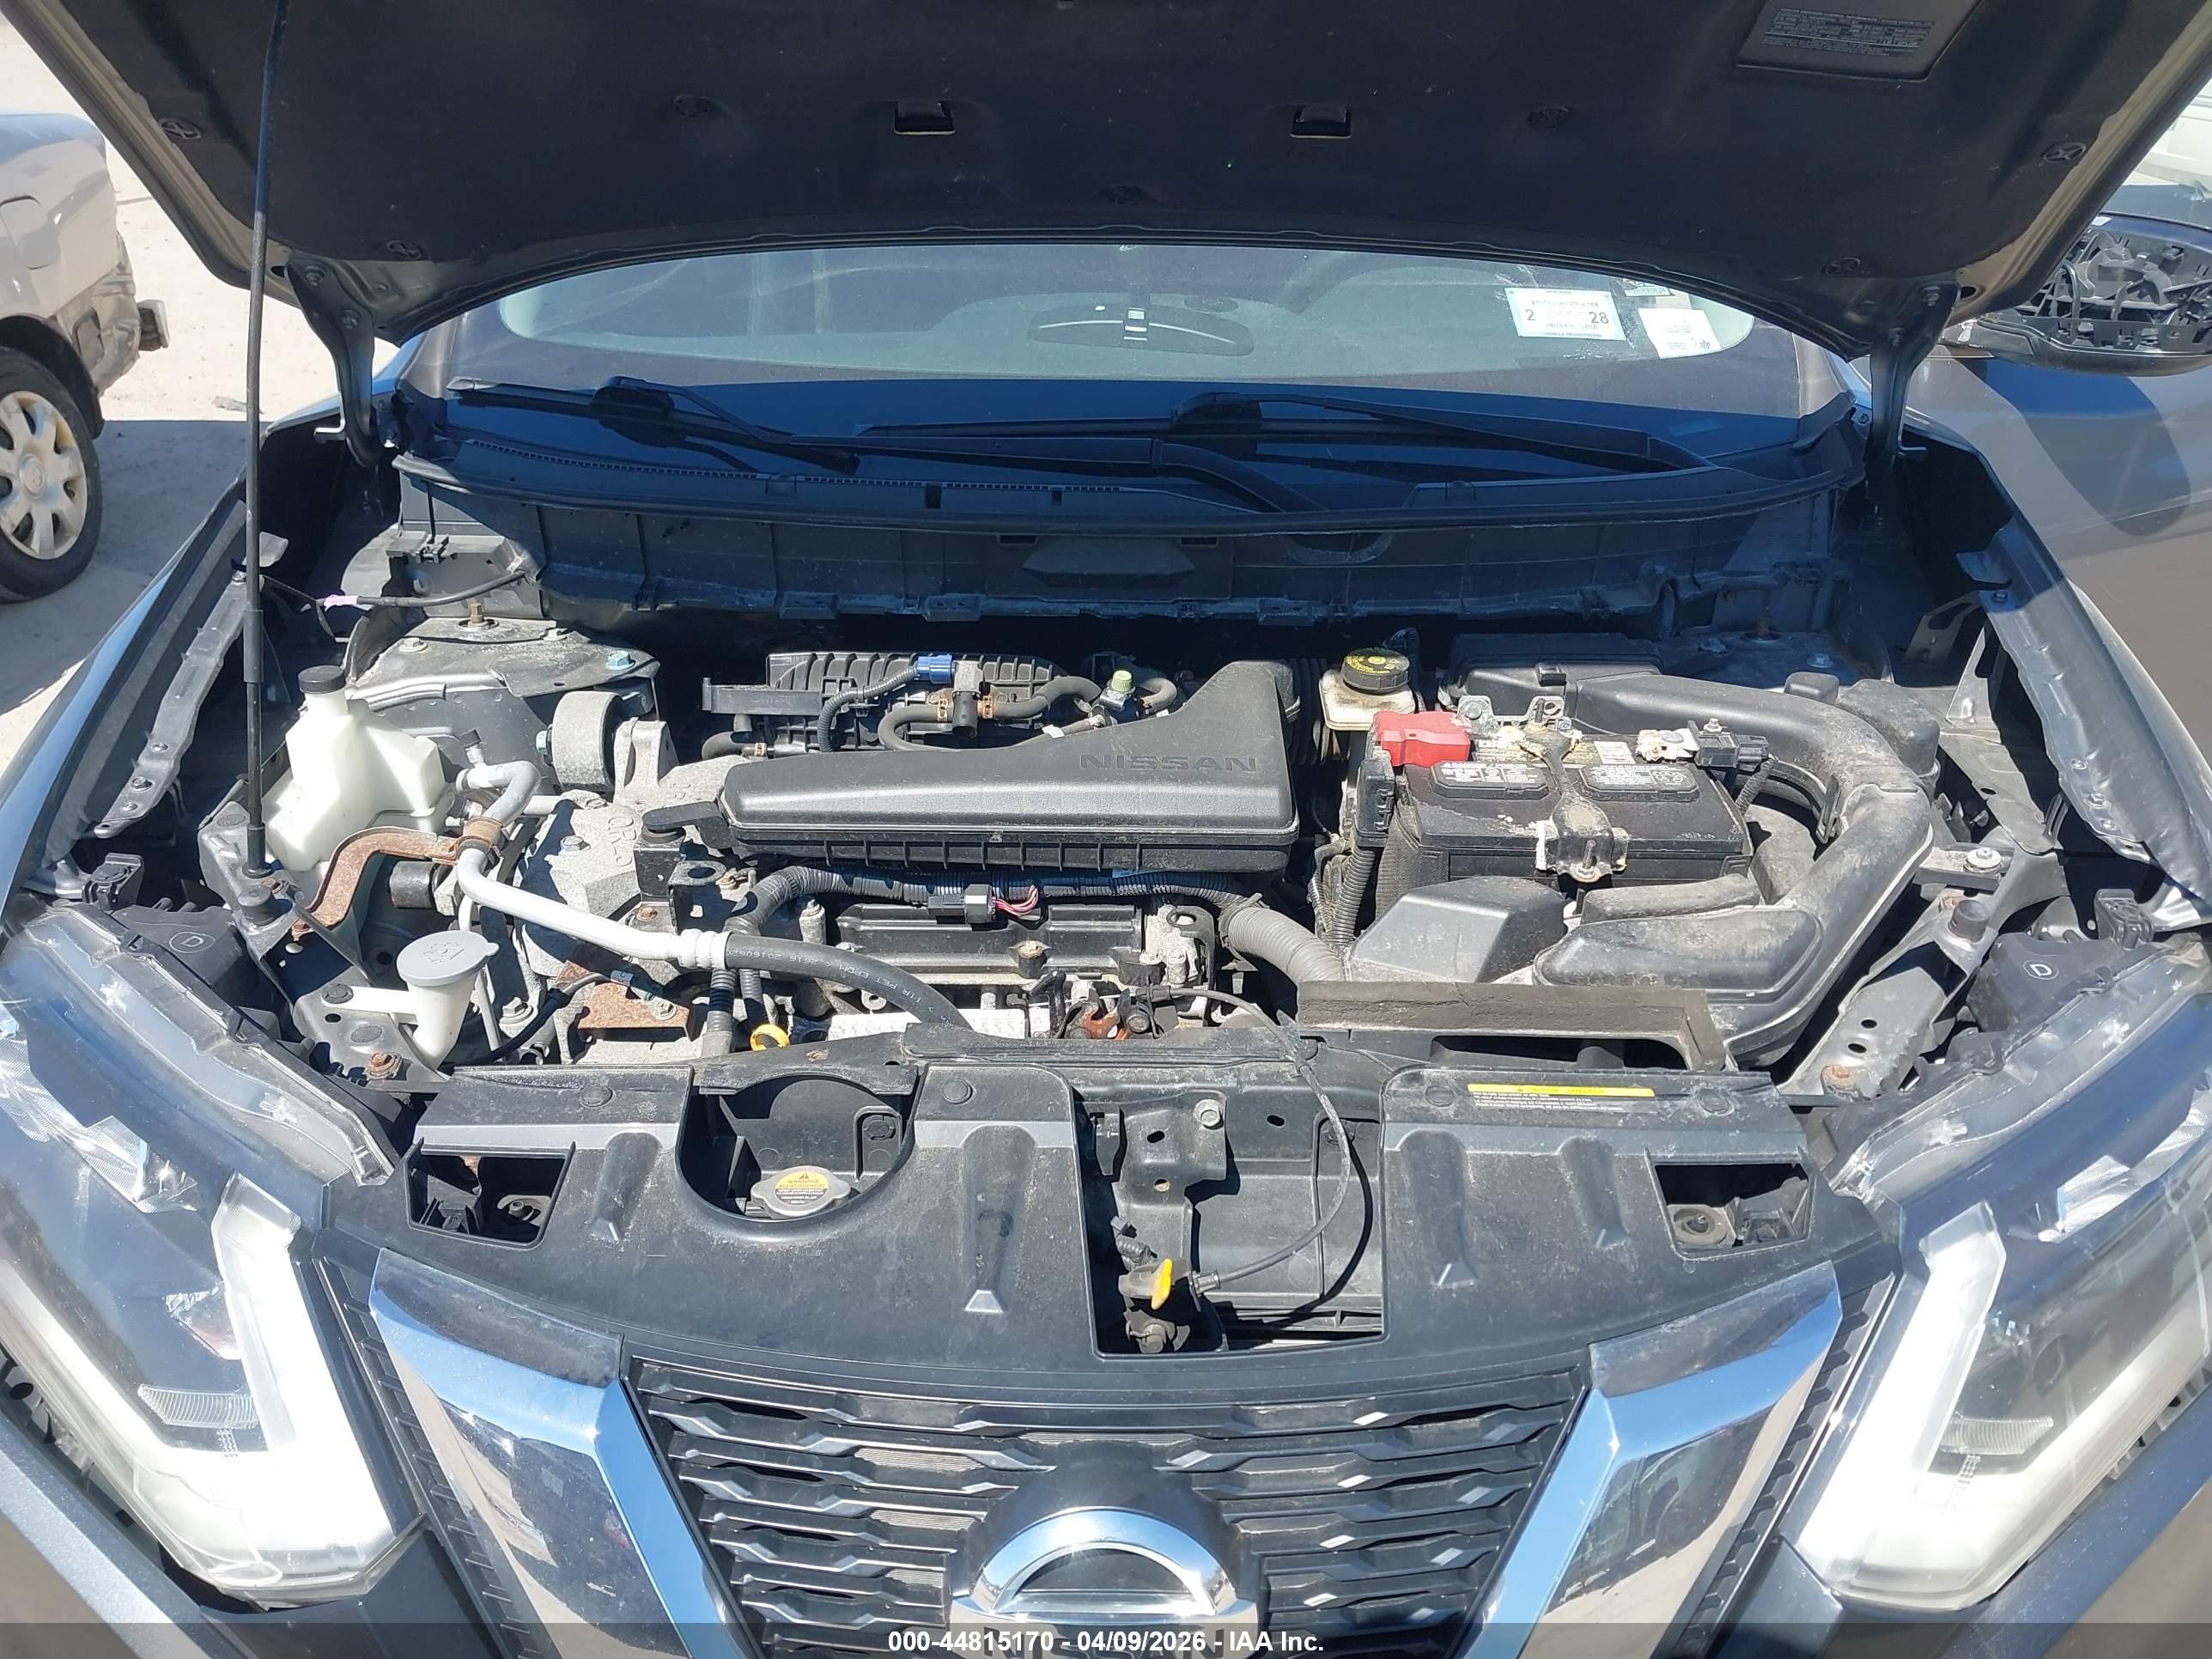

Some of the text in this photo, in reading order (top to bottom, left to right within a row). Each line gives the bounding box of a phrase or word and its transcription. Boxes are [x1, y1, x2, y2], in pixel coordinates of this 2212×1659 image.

[1524, 308, 1609, 325] 2 28
[1079, 755, 1258, 772] NISSAN
[179, 935, 205, 948] D
[838, 963, 870, 979] EPDM
[2029, 963, 2052, 976] D
